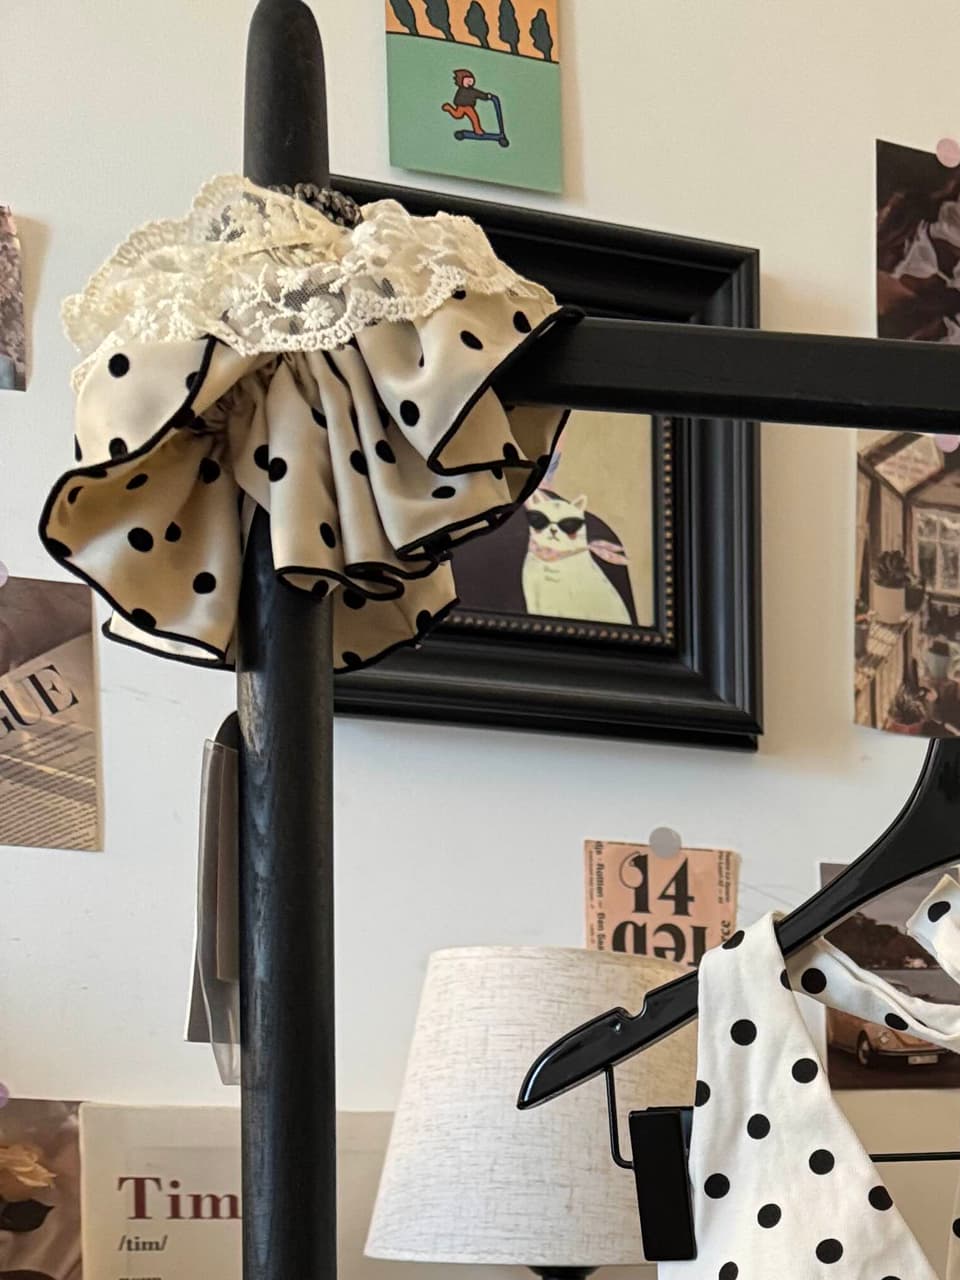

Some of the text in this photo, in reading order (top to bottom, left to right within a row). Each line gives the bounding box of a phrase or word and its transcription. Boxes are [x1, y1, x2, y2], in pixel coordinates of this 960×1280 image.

[619, 851, 696, 917] 14
[117, 1176, 242, 1220] Tim
[118, 1235, 168, 1252] /tim/
